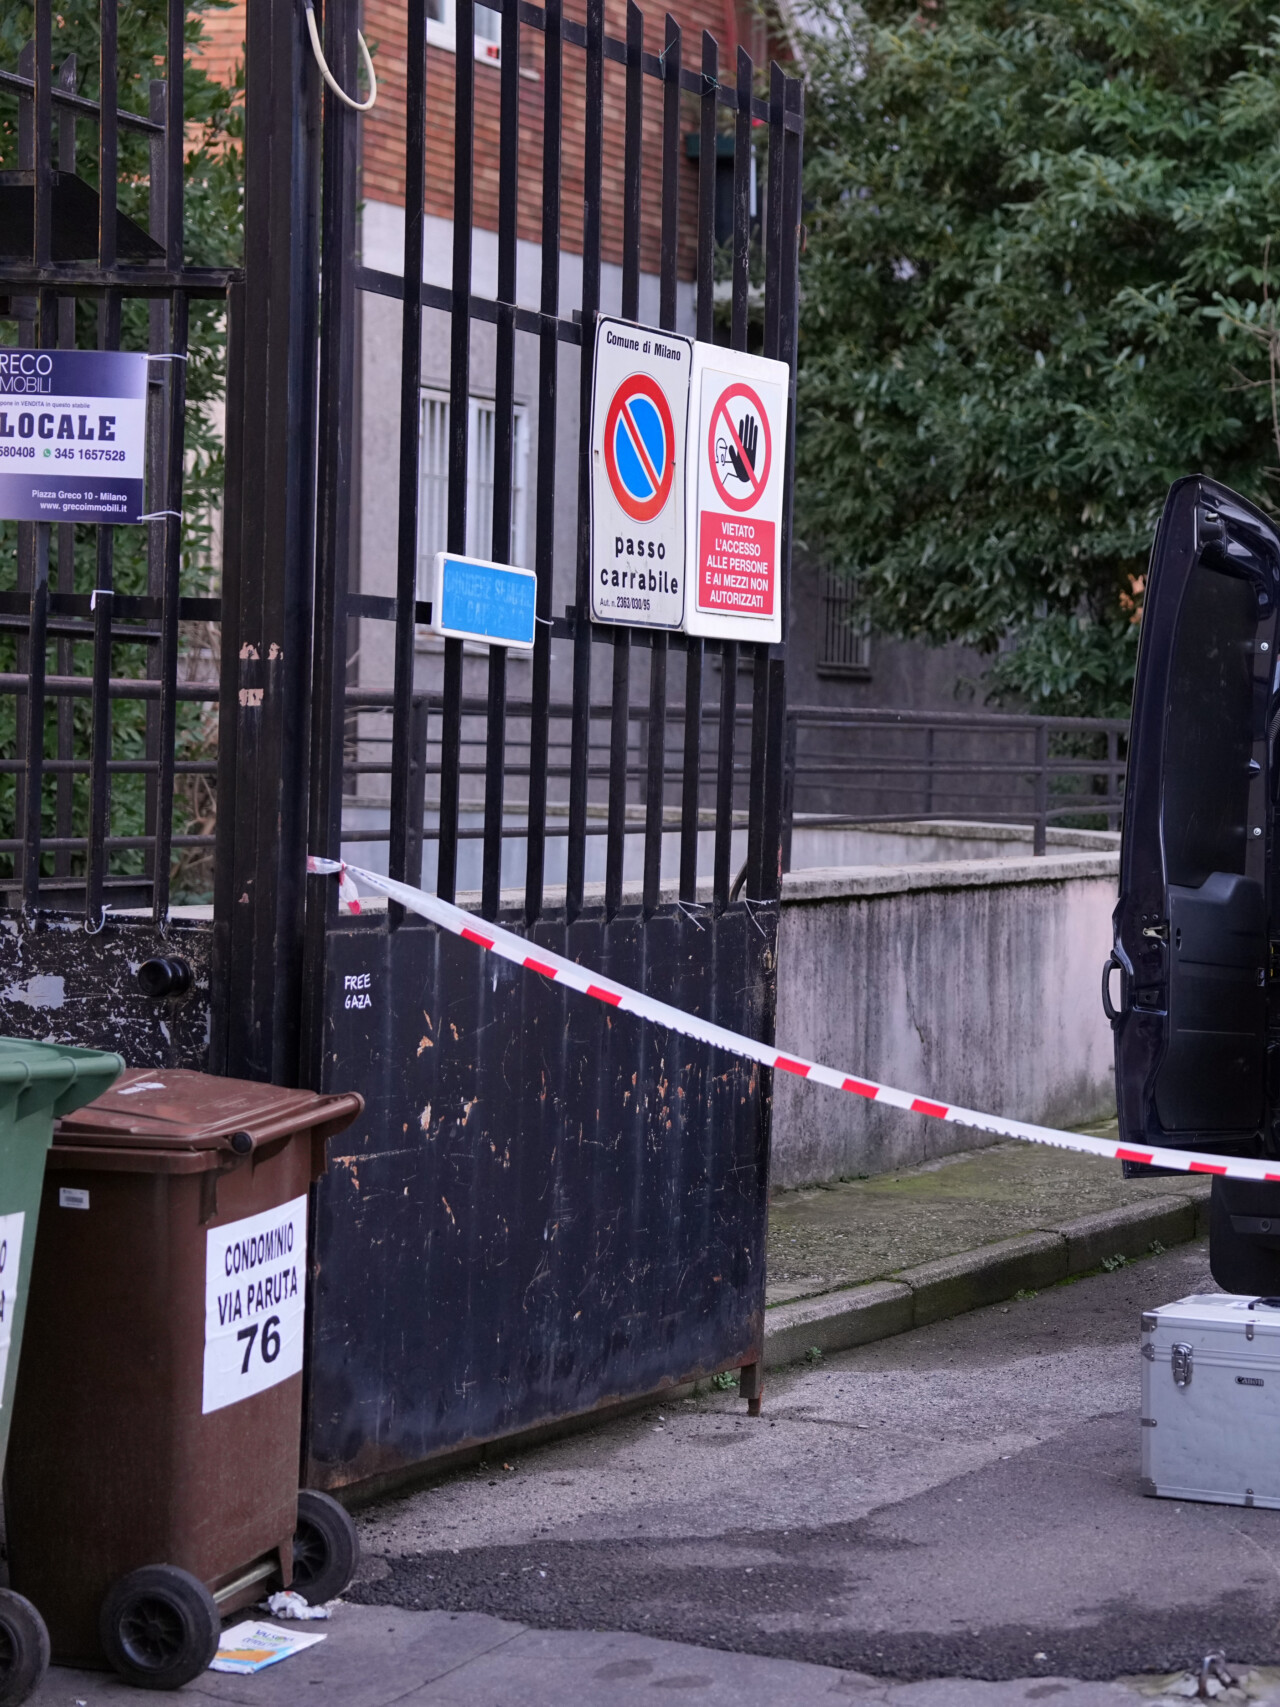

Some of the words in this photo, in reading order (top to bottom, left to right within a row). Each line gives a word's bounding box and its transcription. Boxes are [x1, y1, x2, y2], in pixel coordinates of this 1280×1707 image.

[606, 331, 639, 351] Comune
[643, 341, 651, 354] di
[654, 343, 681, 361] Milano
[54, 448, 75, 459] 345
[78, 449, 126, 461] 1657528
[32, 489, 56, 499] Piazza
[58, 490, 82, 500] Greco
[84, 492, 94, 500] 10
[100, 493, 128, 502] Milano
[721, 521, 755, 539] VIETATO
[615, 536, 666, 560] passo
[715, 538, 761, 557] L'ACCESSO
[706, 554, 728, 570] ALLE
[729, 557, 769, 575] PERSONE
[600, 568, 679, 595] carrabile
[705, 571, 712, 584] E
[712, 572, 722, 586] AI
[723, 573, 749, 589] MEZZI
[750, 577, 769, 592] NON
[709, 589, 764, 608] AUTORIZZATI
[345, 973, 371, 990] FREE
[345, 993, 372, 1009] GAZA
[225, 1221, 294, 1277] CONDOMINIO
[217, 1289, 242, 1326] VIA
[247, 1265, 298, 1316] PARUTA
[237, 1315, 281, 1375] 76
[1235, 1376, 1264, 1387] Canon
